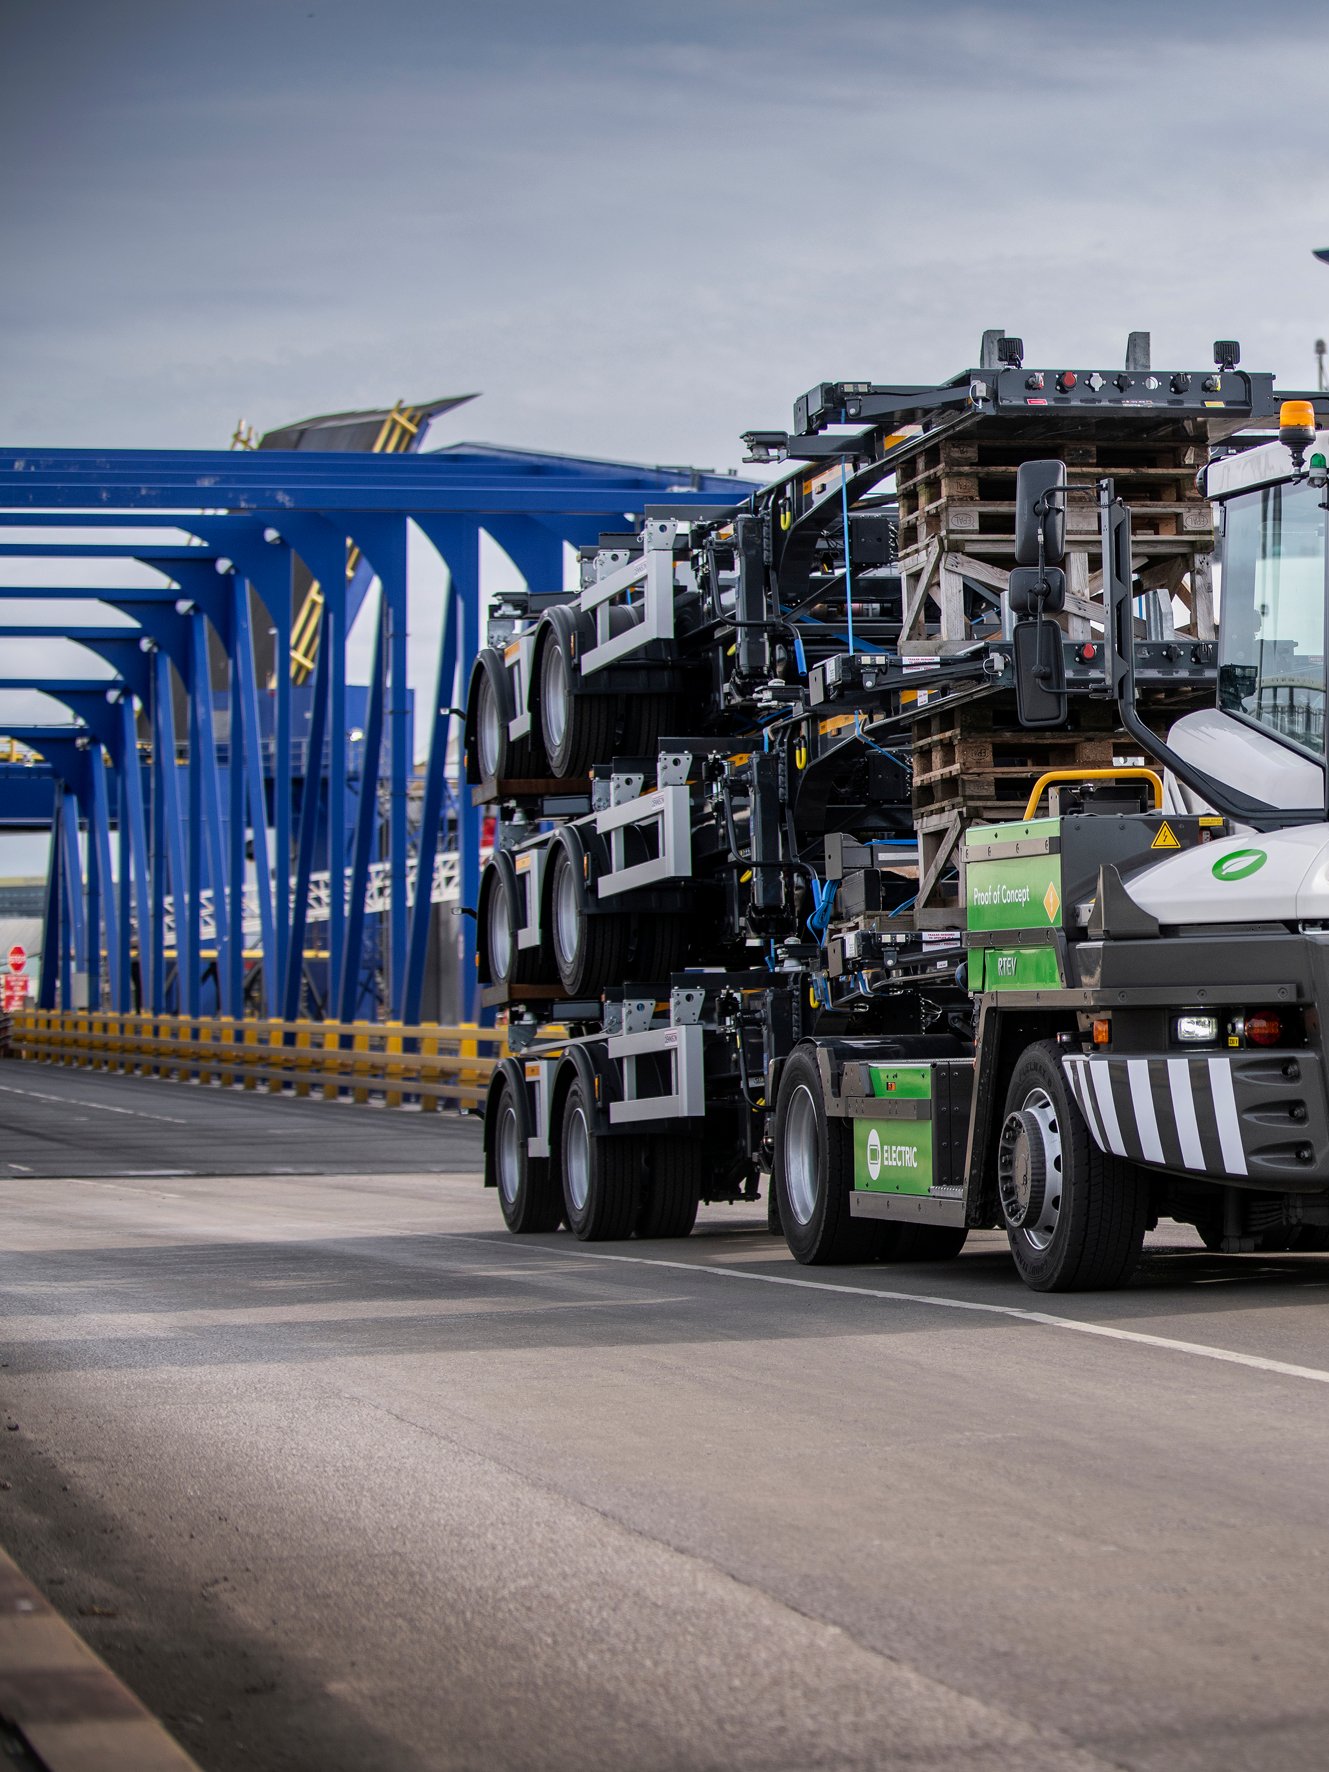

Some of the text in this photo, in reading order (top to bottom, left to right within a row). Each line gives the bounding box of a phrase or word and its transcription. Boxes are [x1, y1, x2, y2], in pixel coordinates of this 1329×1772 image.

[973, 884, 1030, 907] Proof of Concept
[998, 957, 1018, 976] RTEV
[883, 1145, 918, 1168] ELECTRIC
